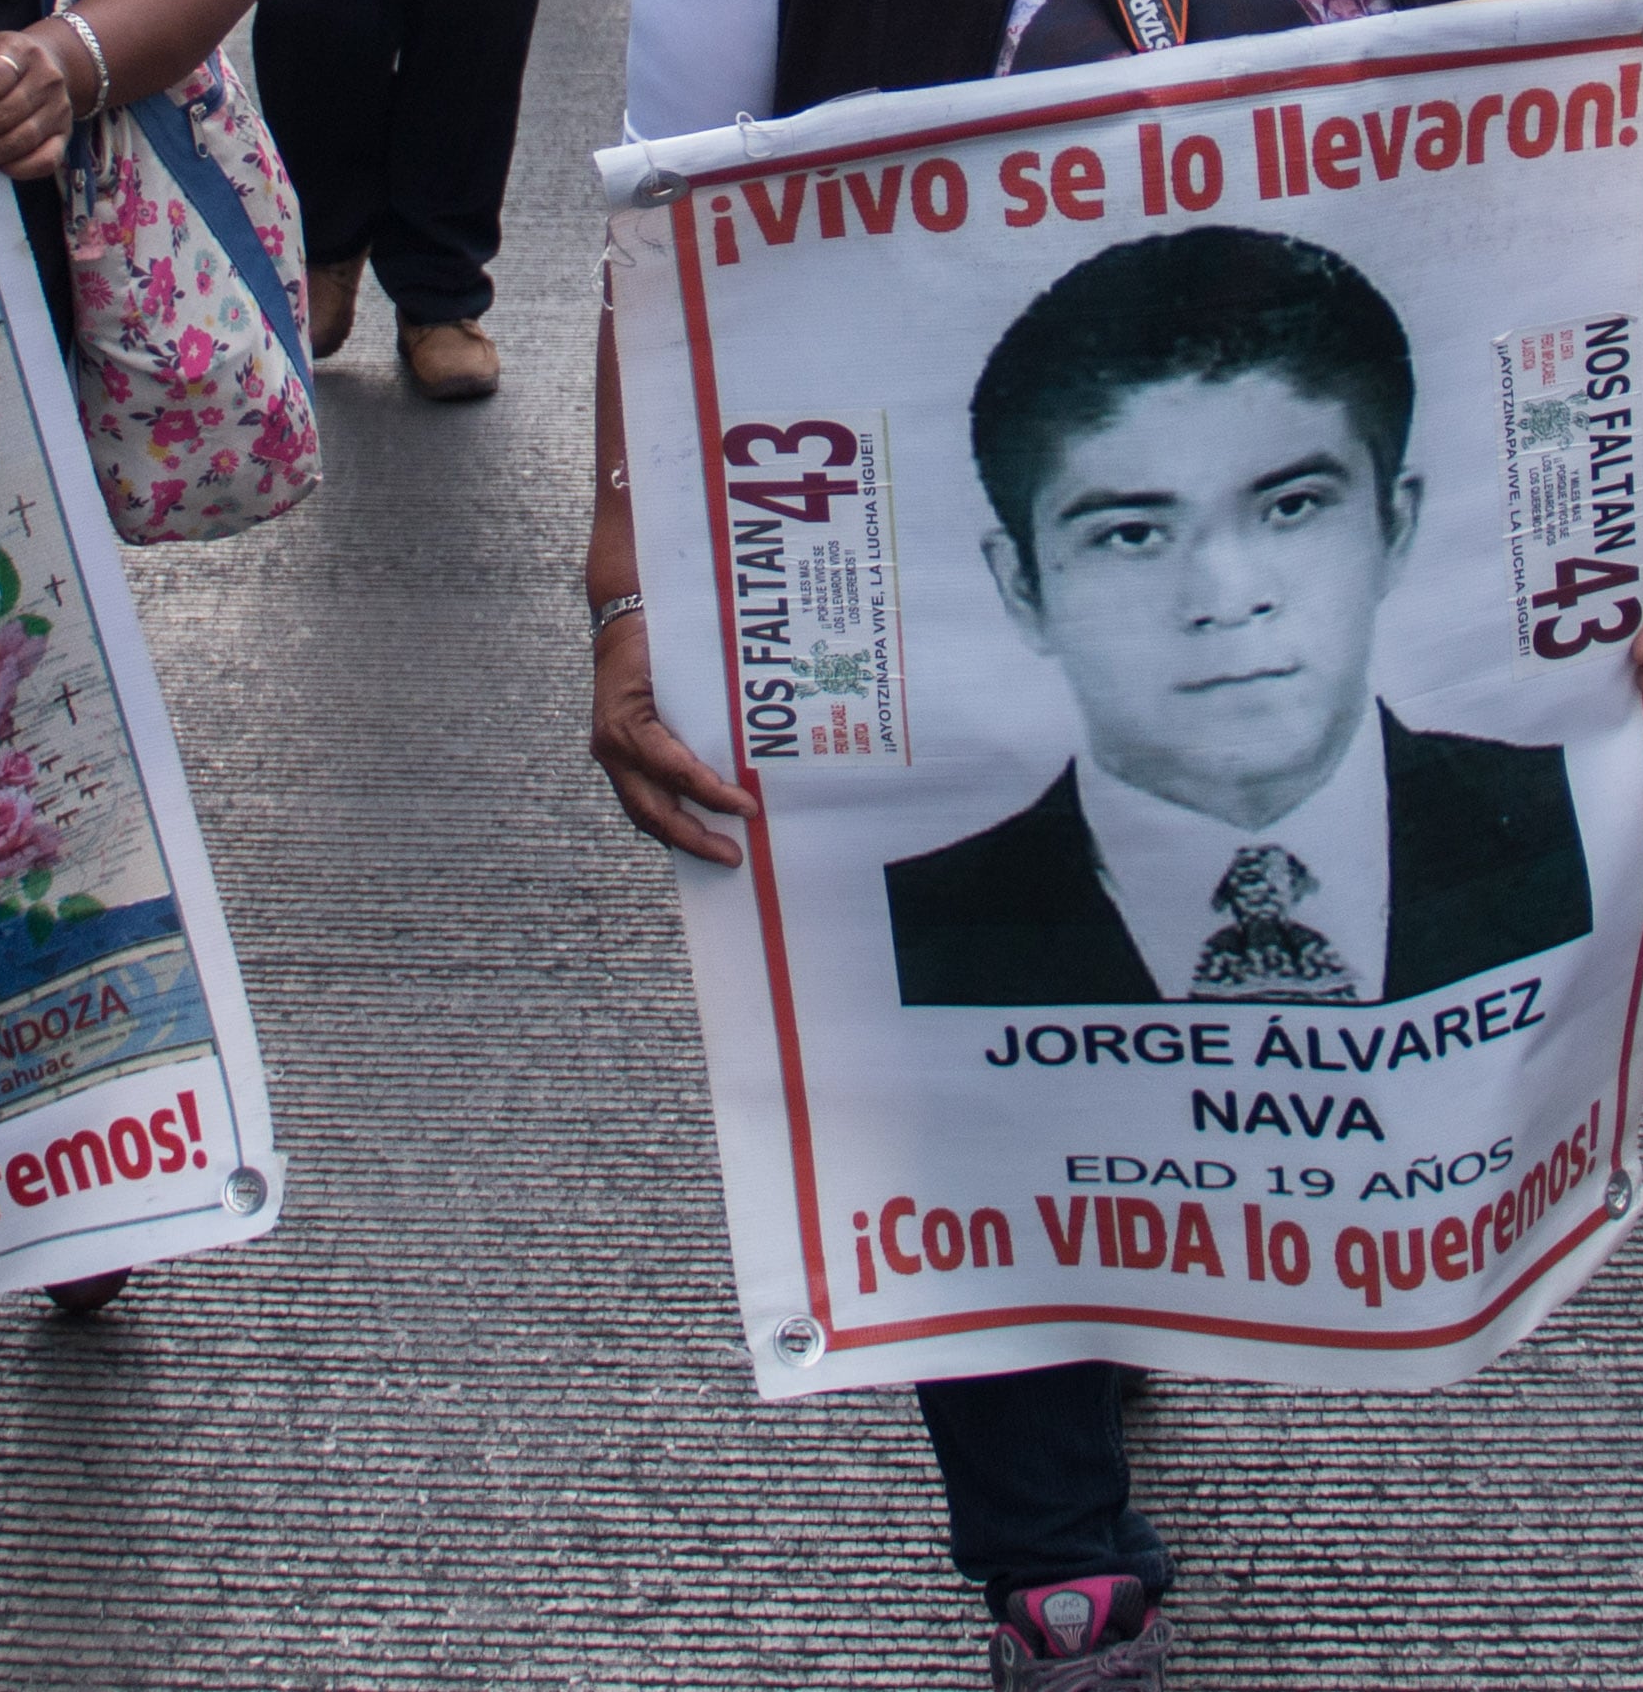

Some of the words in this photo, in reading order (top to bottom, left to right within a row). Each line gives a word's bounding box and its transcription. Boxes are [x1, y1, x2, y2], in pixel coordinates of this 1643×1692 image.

[709, 154, 970, 268] ¡Vivo
[998, 142, 1106, 228] se
[1139, 120, 1224, 216] lo
[1251, 61, 1642, 202] llevaron!
[1583, 316, 1631, 403] NOS
[722, 419, 859, 524] 43
[859, 432, 877, 497] SIGUE!!
[1589, 407, 1638, 555] FALTAN
[864, 501, 882, 559] LUCHA
[1509, 510, 1523, 533] LA
[733, 518, 793, 666] FALTAN
[815, 586, 829, 622] PORQUE
[867, 564, 883, 586] LA
[1511, 536, 1526, 592] LUCHA
[1531, 556, 1643, 662] 43
[744, 678, 801, 759] NOS
[872, 636, 898, 754] ¡¡AYOTZINAPA
[984, 1021, 1235, 1067] JORGE
[1254, 975, 1549, 1074] ÁLVAREZ
[1189, 1089, 1387, 1143] NAVA
[851, 1194, 1018, 1297] ¡Con
[1035, 1194, 1228, 1279] VIDA
[1244, 1202, 1313, 1287] lo
[1334, 1099, 1607, 1309] queremos!
[1064, 1154, 1239, 1192] EDAD
[1267, 1163, 1338, 1199] 19
[1357, 1135, 1518, 1203] AÑOS
